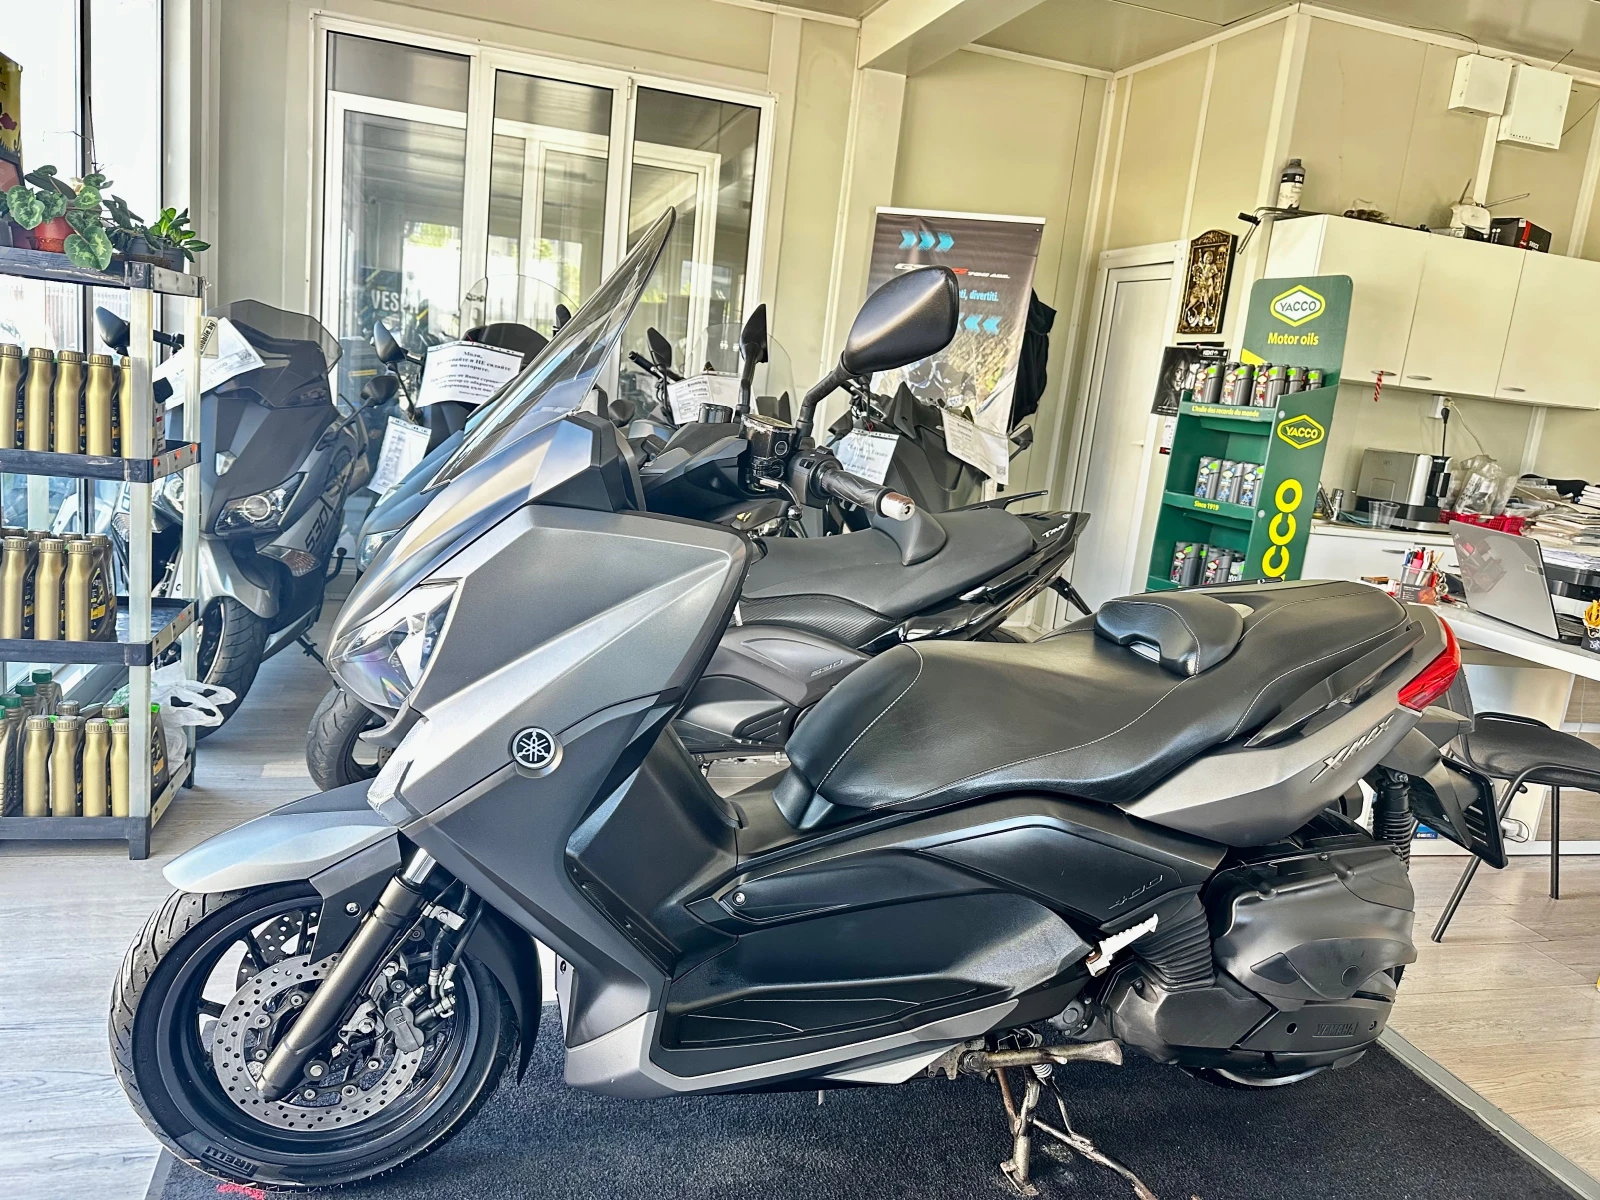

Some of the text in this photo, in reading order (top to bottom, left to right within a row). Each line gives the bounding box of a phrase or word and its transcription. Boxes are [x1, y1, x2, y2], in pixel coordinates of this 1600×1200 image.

[969, 289, 999, 302] divertiti.
[1280, 301, 1316, 312] YACCO
[1267, 332, 1319, 346] Motor oils
[1285, 426, 1318, 439] YACCO
[1193, 500, 1220, 511] Since 1919
[305, 505, 329, 553] 530
[1261, 478, 1303, 579] CCO
[810, 658, 843, 677] 530
[1316, 1022, 1355, 1036] YAMAHA
